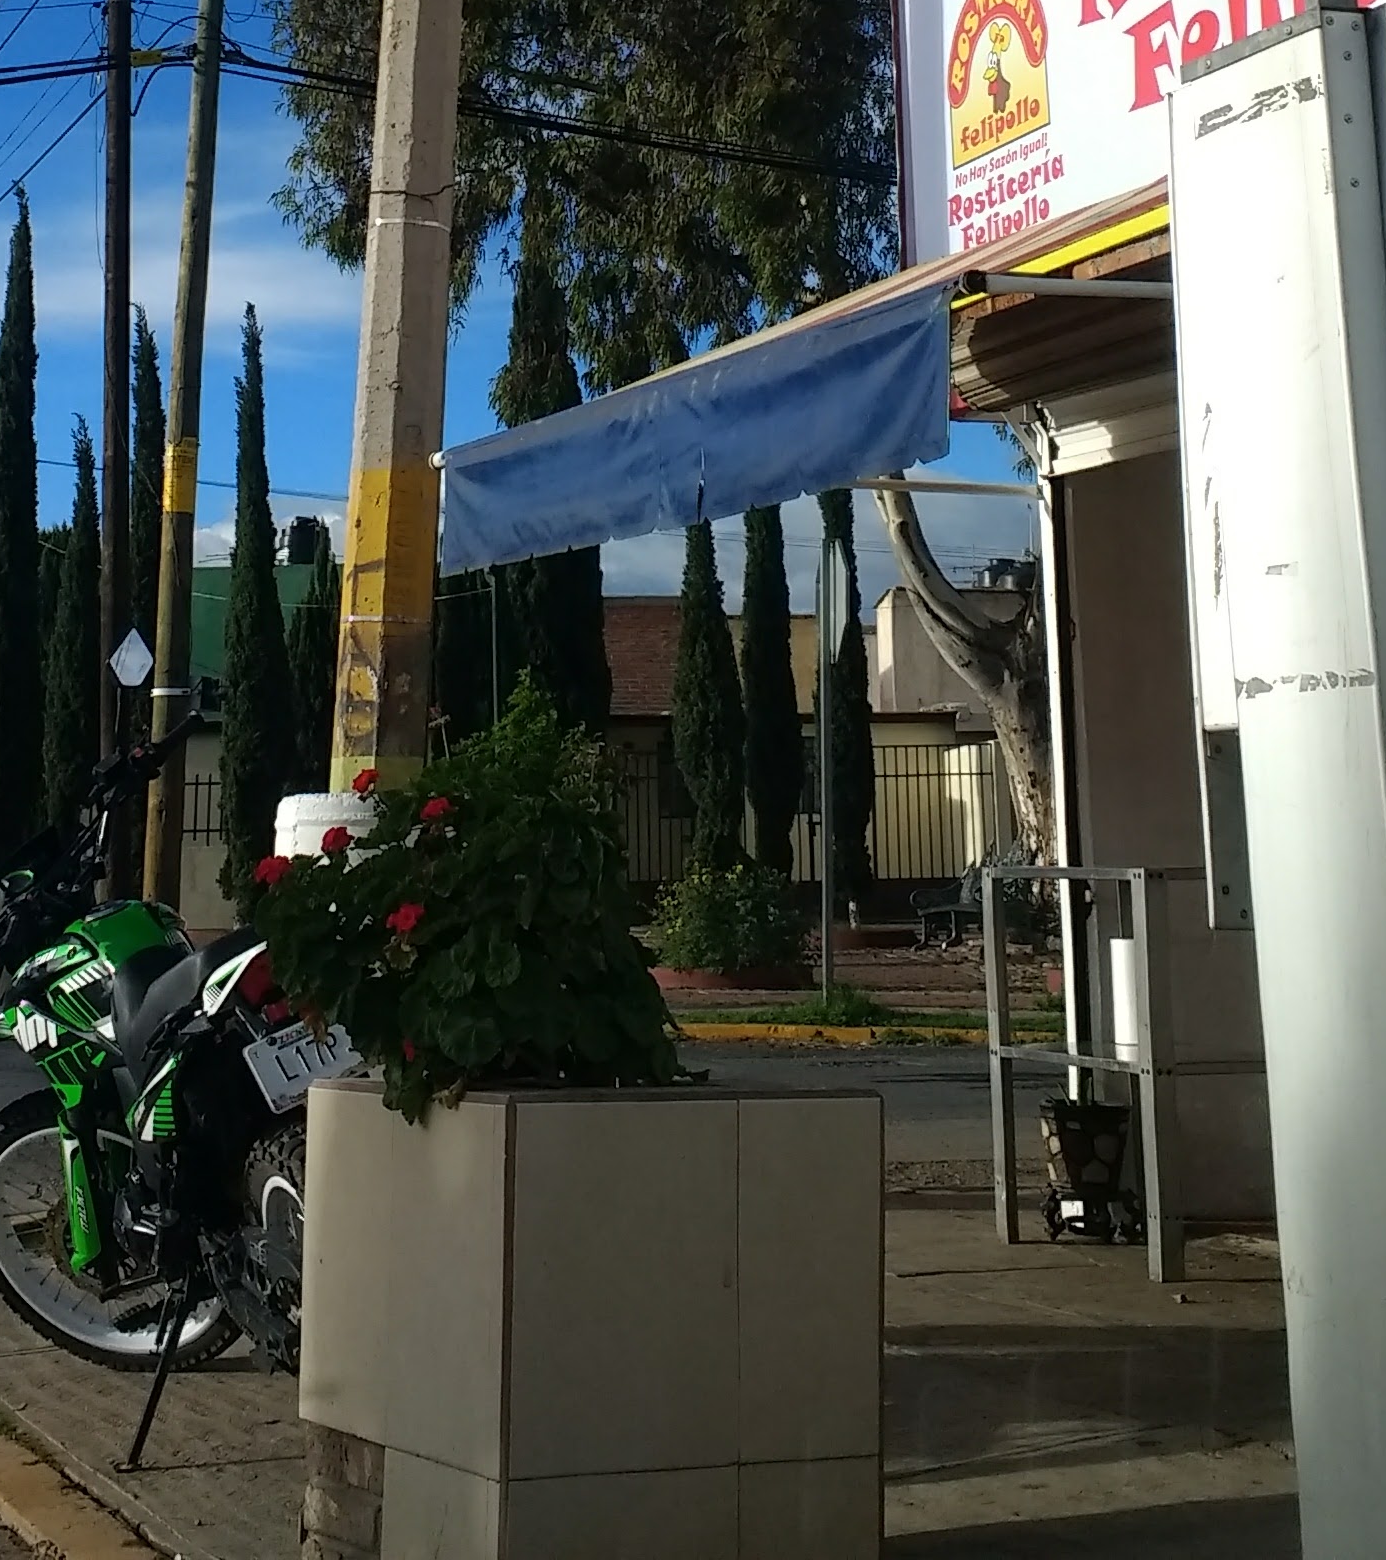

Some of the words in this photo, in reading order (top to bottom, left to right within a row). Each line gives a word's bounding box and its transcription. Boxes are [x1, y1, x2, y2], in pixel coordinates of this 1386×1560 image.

[960, 95, 1041, 153] felipollo
[948, 148, 1065, 227] Rosticería
[954, 172, 969, 189] No
[969, 163, 988, 182] Hay
[988, 148, 1018, 173] Sazón
[1019, 132, 1049, 161] Igual!
[960, 194, 1050, 251] Felipollo
